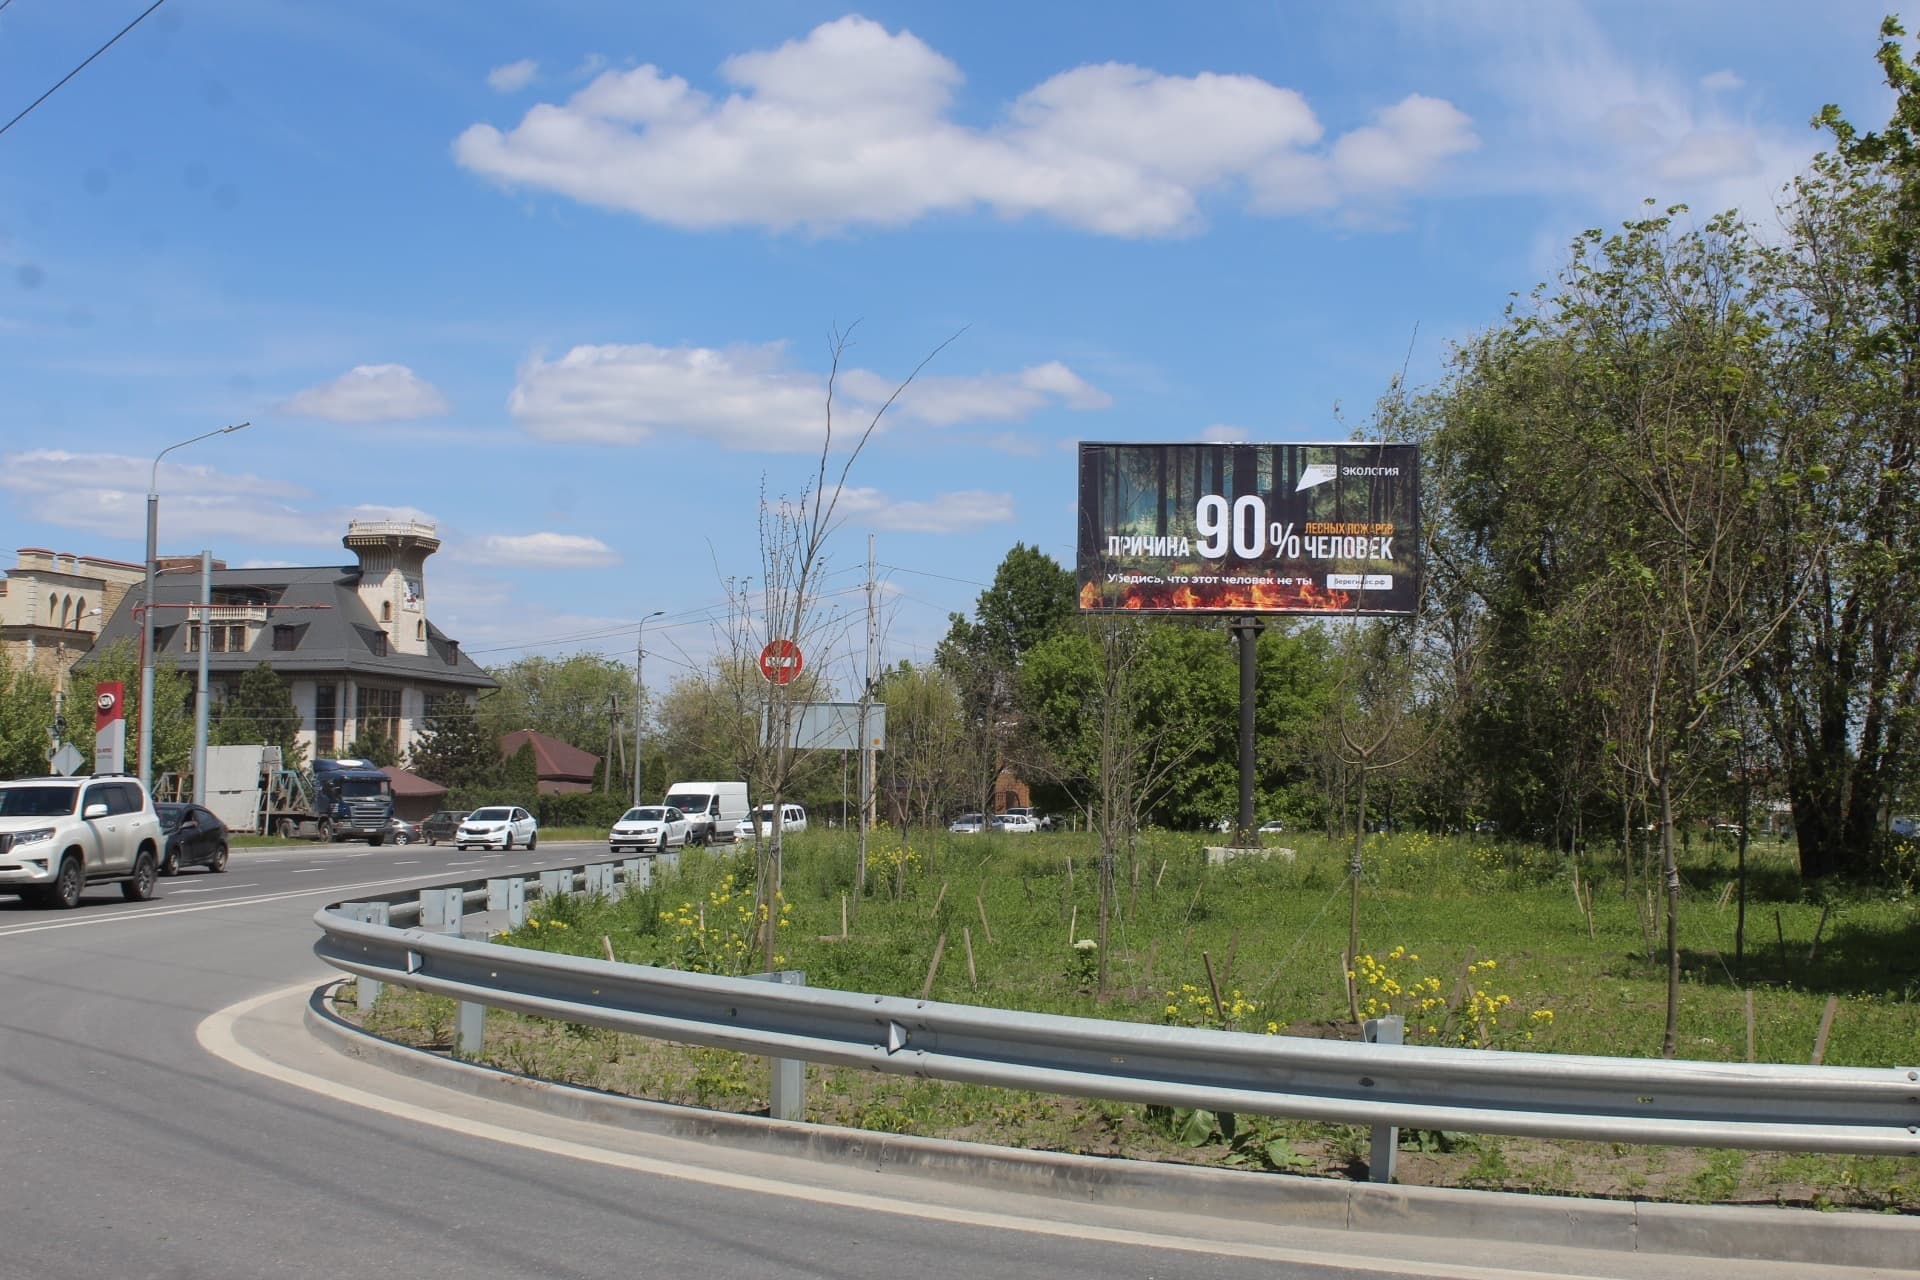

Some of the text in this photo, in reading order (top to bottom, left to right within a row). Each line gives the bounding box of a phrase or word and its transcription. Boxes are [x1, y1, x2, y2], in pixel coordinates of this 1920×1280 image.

[1342, 466, 1399, 476] ЭКОЛОГИЯ
[1305, 522, 1345, 534] ЛЕСНЫХ
[1108, 535, 1190, 557] ПРИЧИНА
[1304, 535, 1394, 560] ЧЕЛОВЕК
[1167, 575, 1188, 584] что
[1191, 576, 1219, 584] этот
[1221, 576, 1274, 585] человек
[1277, 577, 1293, 585] не
[1295, 577, 1312, 585] ты
[1334, 577, 1386, 587] берегиес.рф
